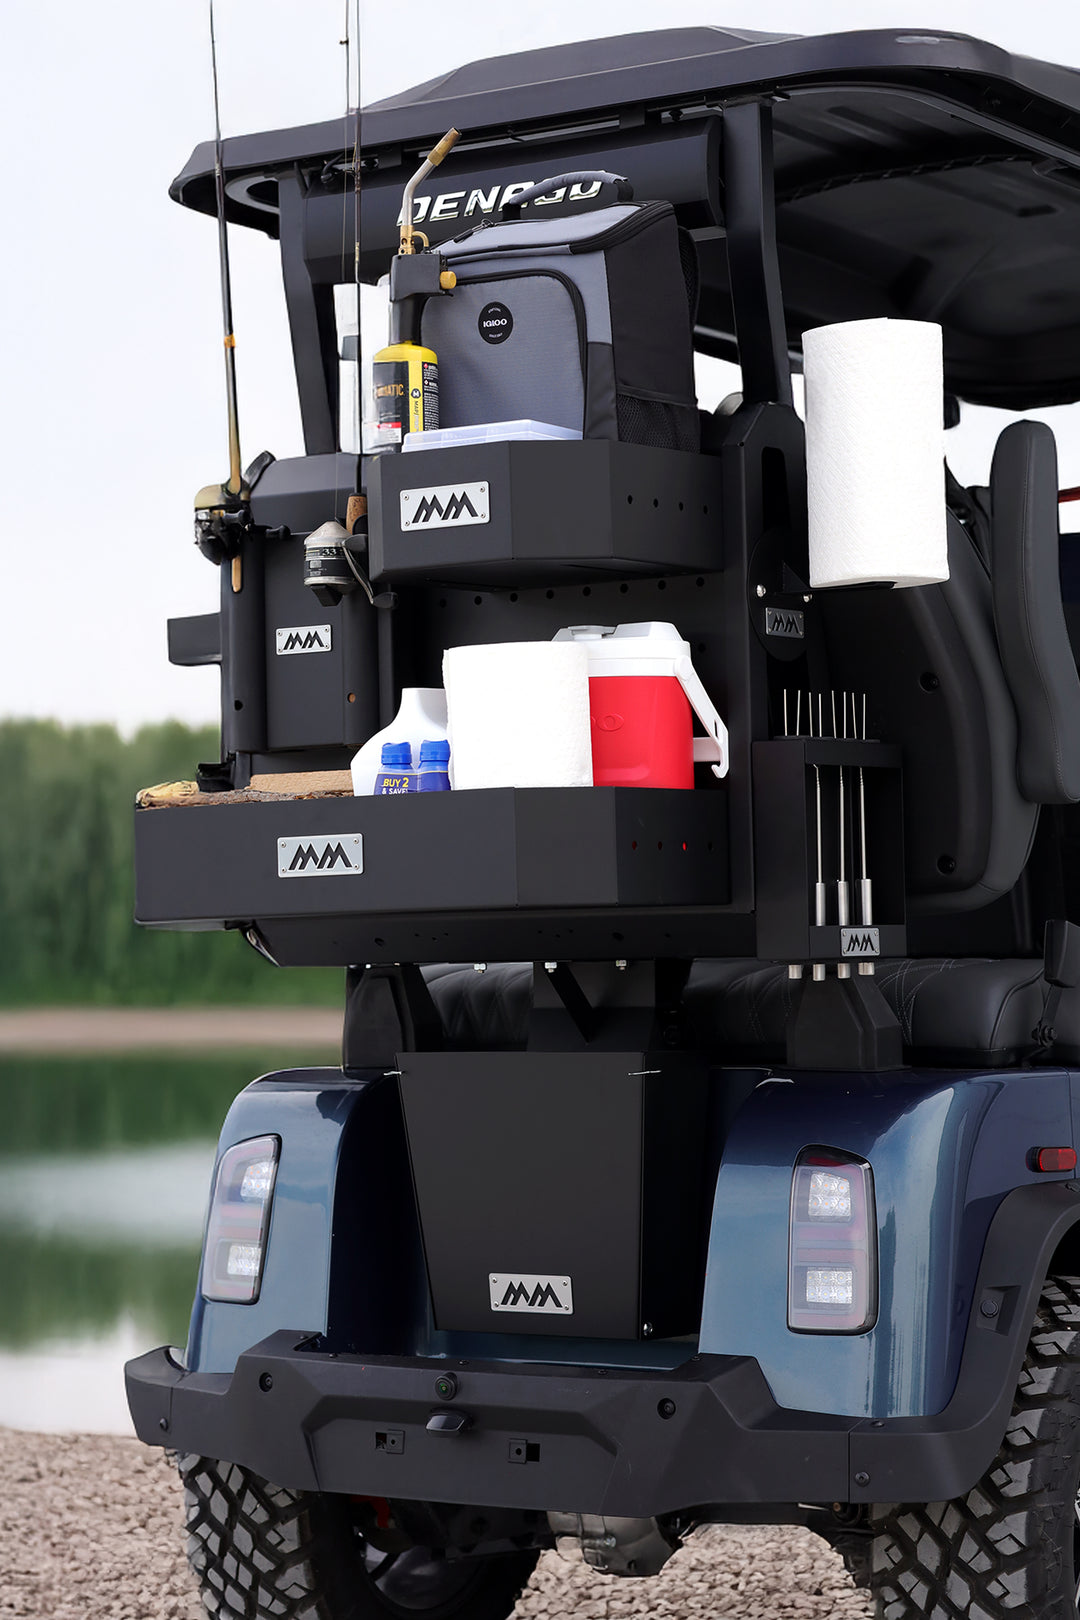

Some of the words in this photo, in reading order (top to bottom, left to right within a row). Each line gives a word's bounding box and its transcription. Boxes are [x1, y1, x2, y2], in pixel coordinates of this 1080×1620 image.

[483, 318, 508, 328] IGLOO
[322, 548, 338, 556] 33
[383, 778, 401, 787] BUY
[402, 777, 409, 787] 2
